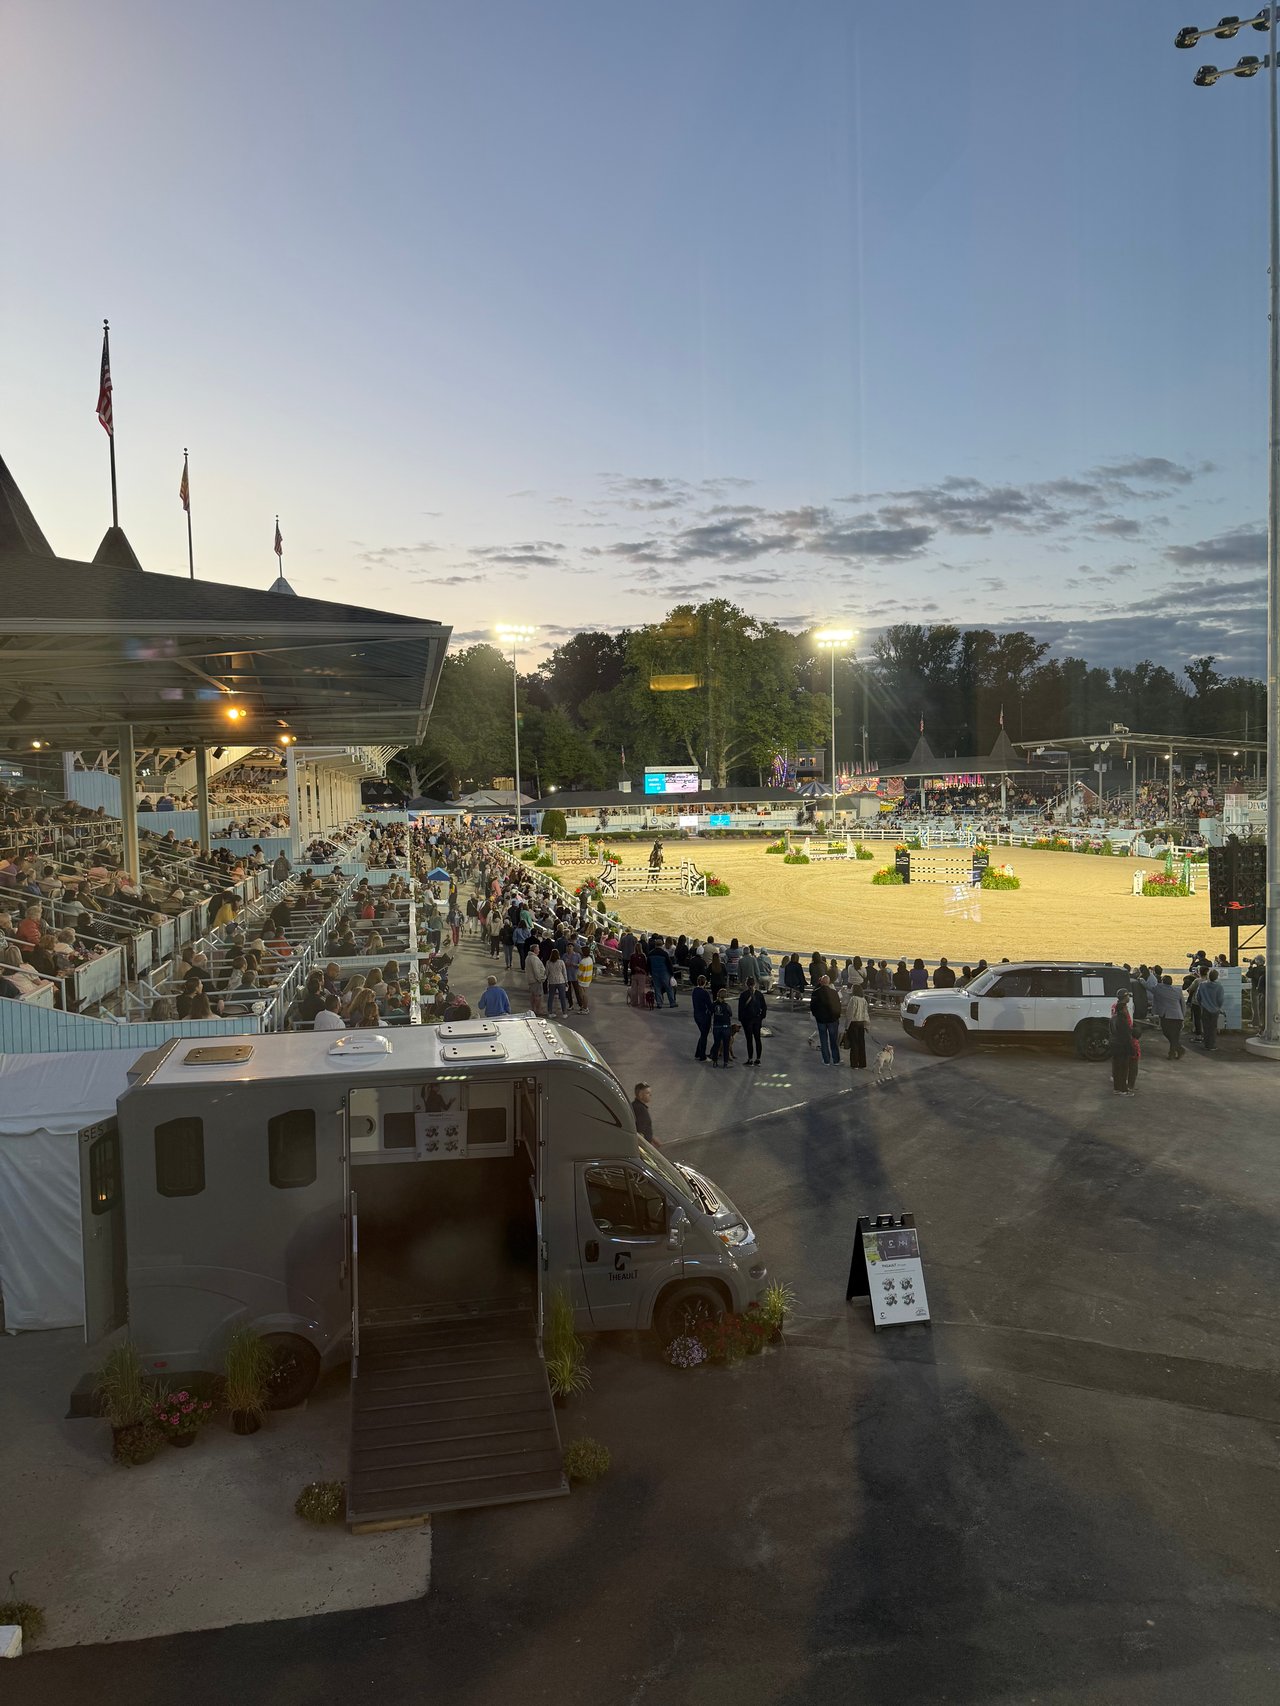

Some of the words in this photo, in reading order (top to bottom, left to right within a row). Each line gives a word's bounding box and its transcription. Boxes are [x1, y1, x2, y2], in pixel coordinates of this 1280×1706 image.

[1247, 801, 1268, 811] DEVO
[81, 1123, 104, 1143] SES
[608, 1269, 639, 1281] THEAULT
